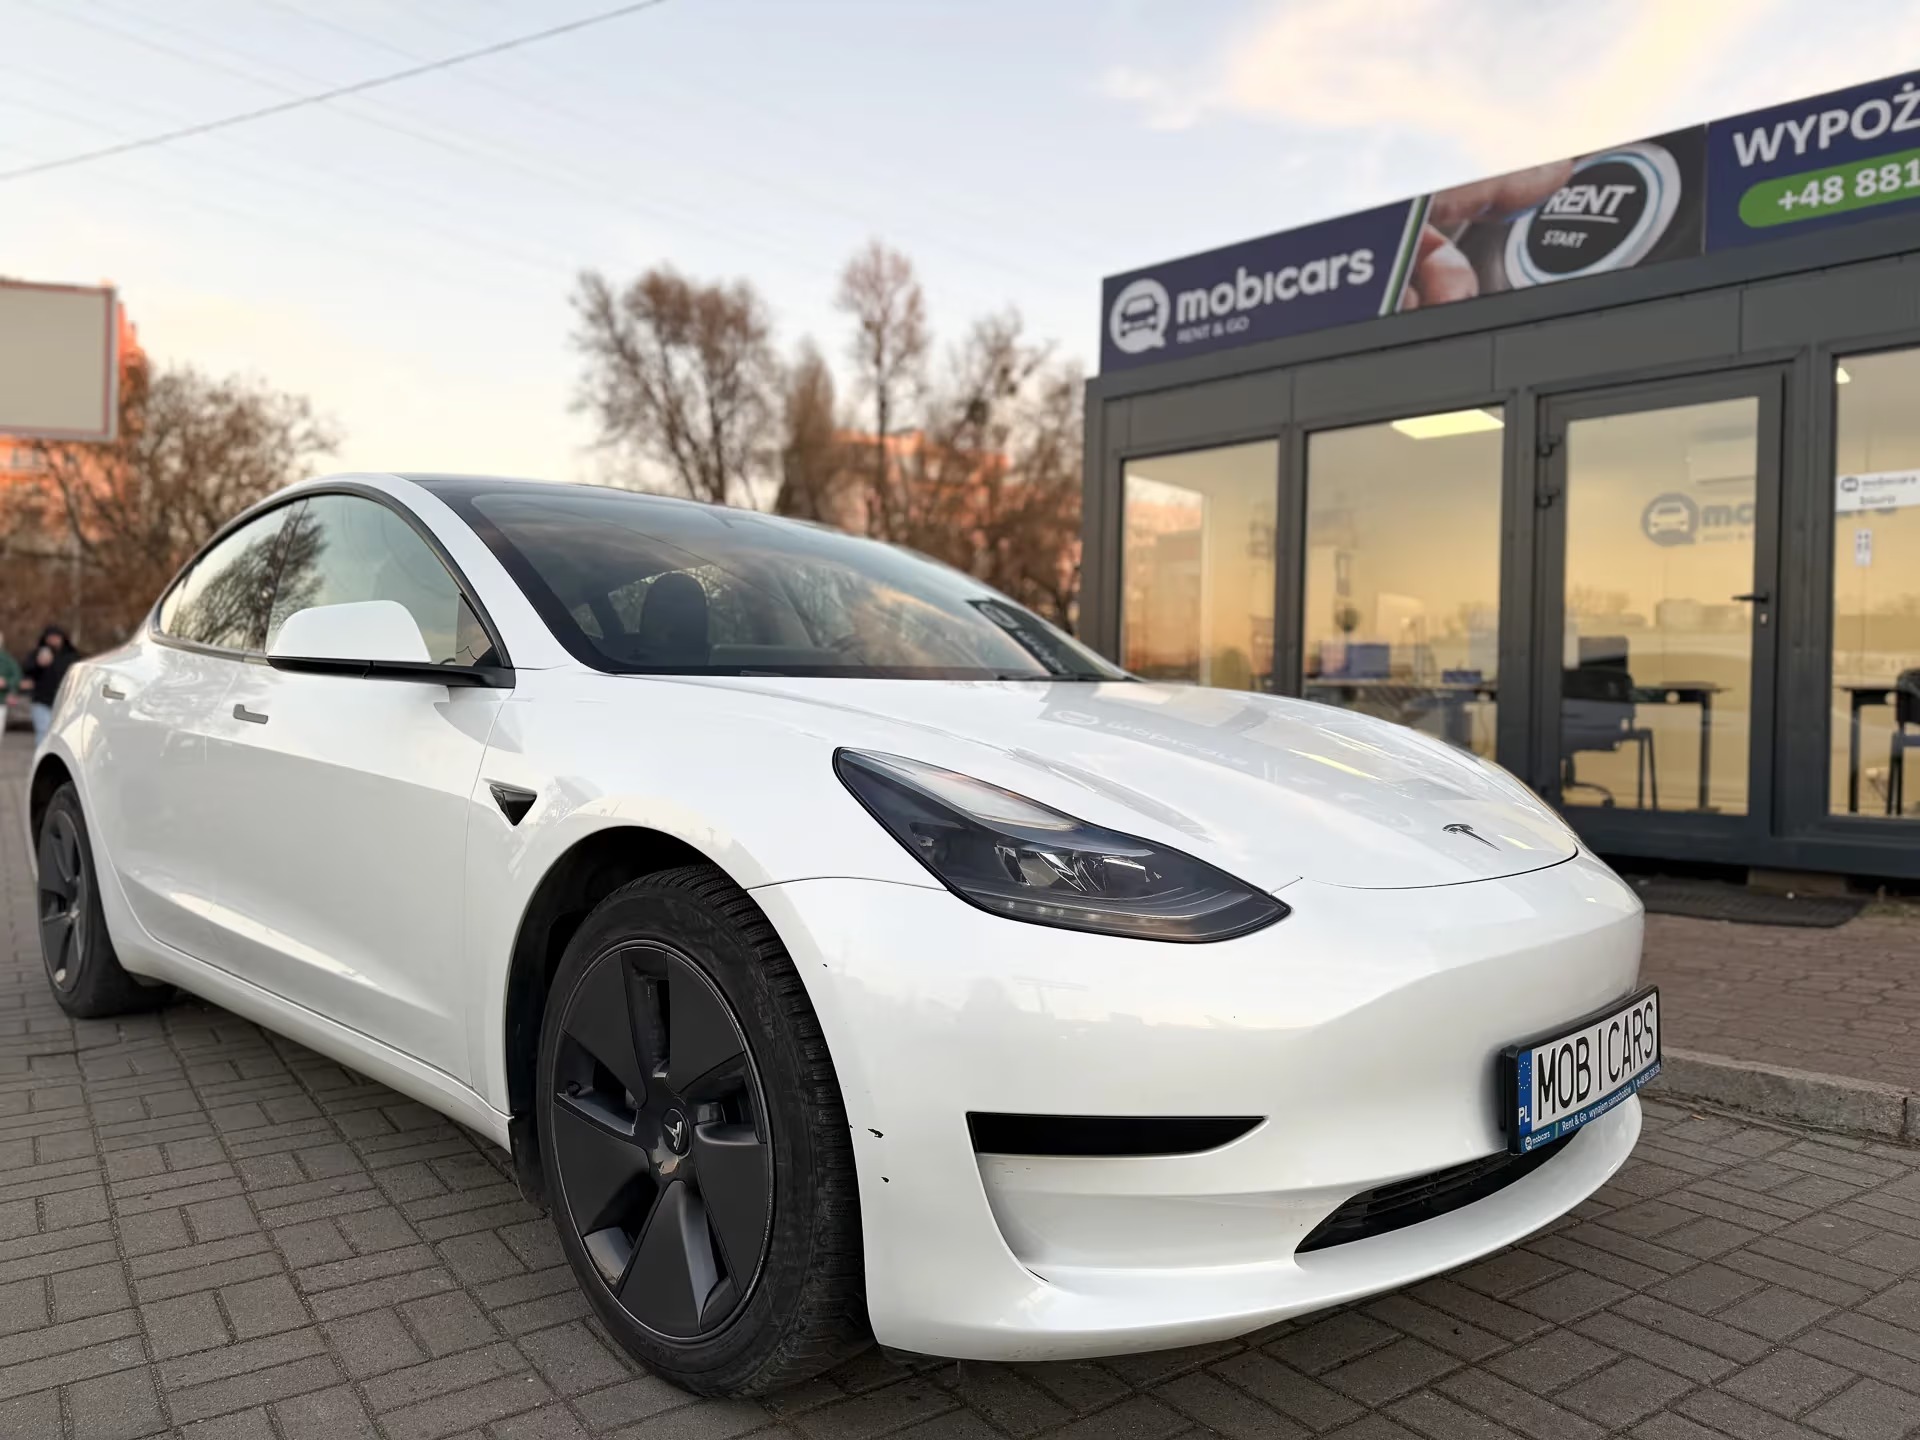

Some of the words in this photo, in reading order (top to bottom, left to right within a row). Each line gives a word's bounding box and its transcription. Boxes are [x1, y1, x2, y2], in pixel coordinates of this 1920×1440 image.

[1777, 175, 1845, 212] +48
[1854, 158, 1920, 198] 881
[1543, 184, 1636, 216] RENT
[1541, 229, 1588, 249] START
[1176, 249, 1375, 325] mobicars
[1518, 1105, 1530, 1126] PL
[1562, 1117, 1574, 1131] Rent
[1574, 1114, 1580, 1125] &
[1580, 1112, 1587, 1122] Go
